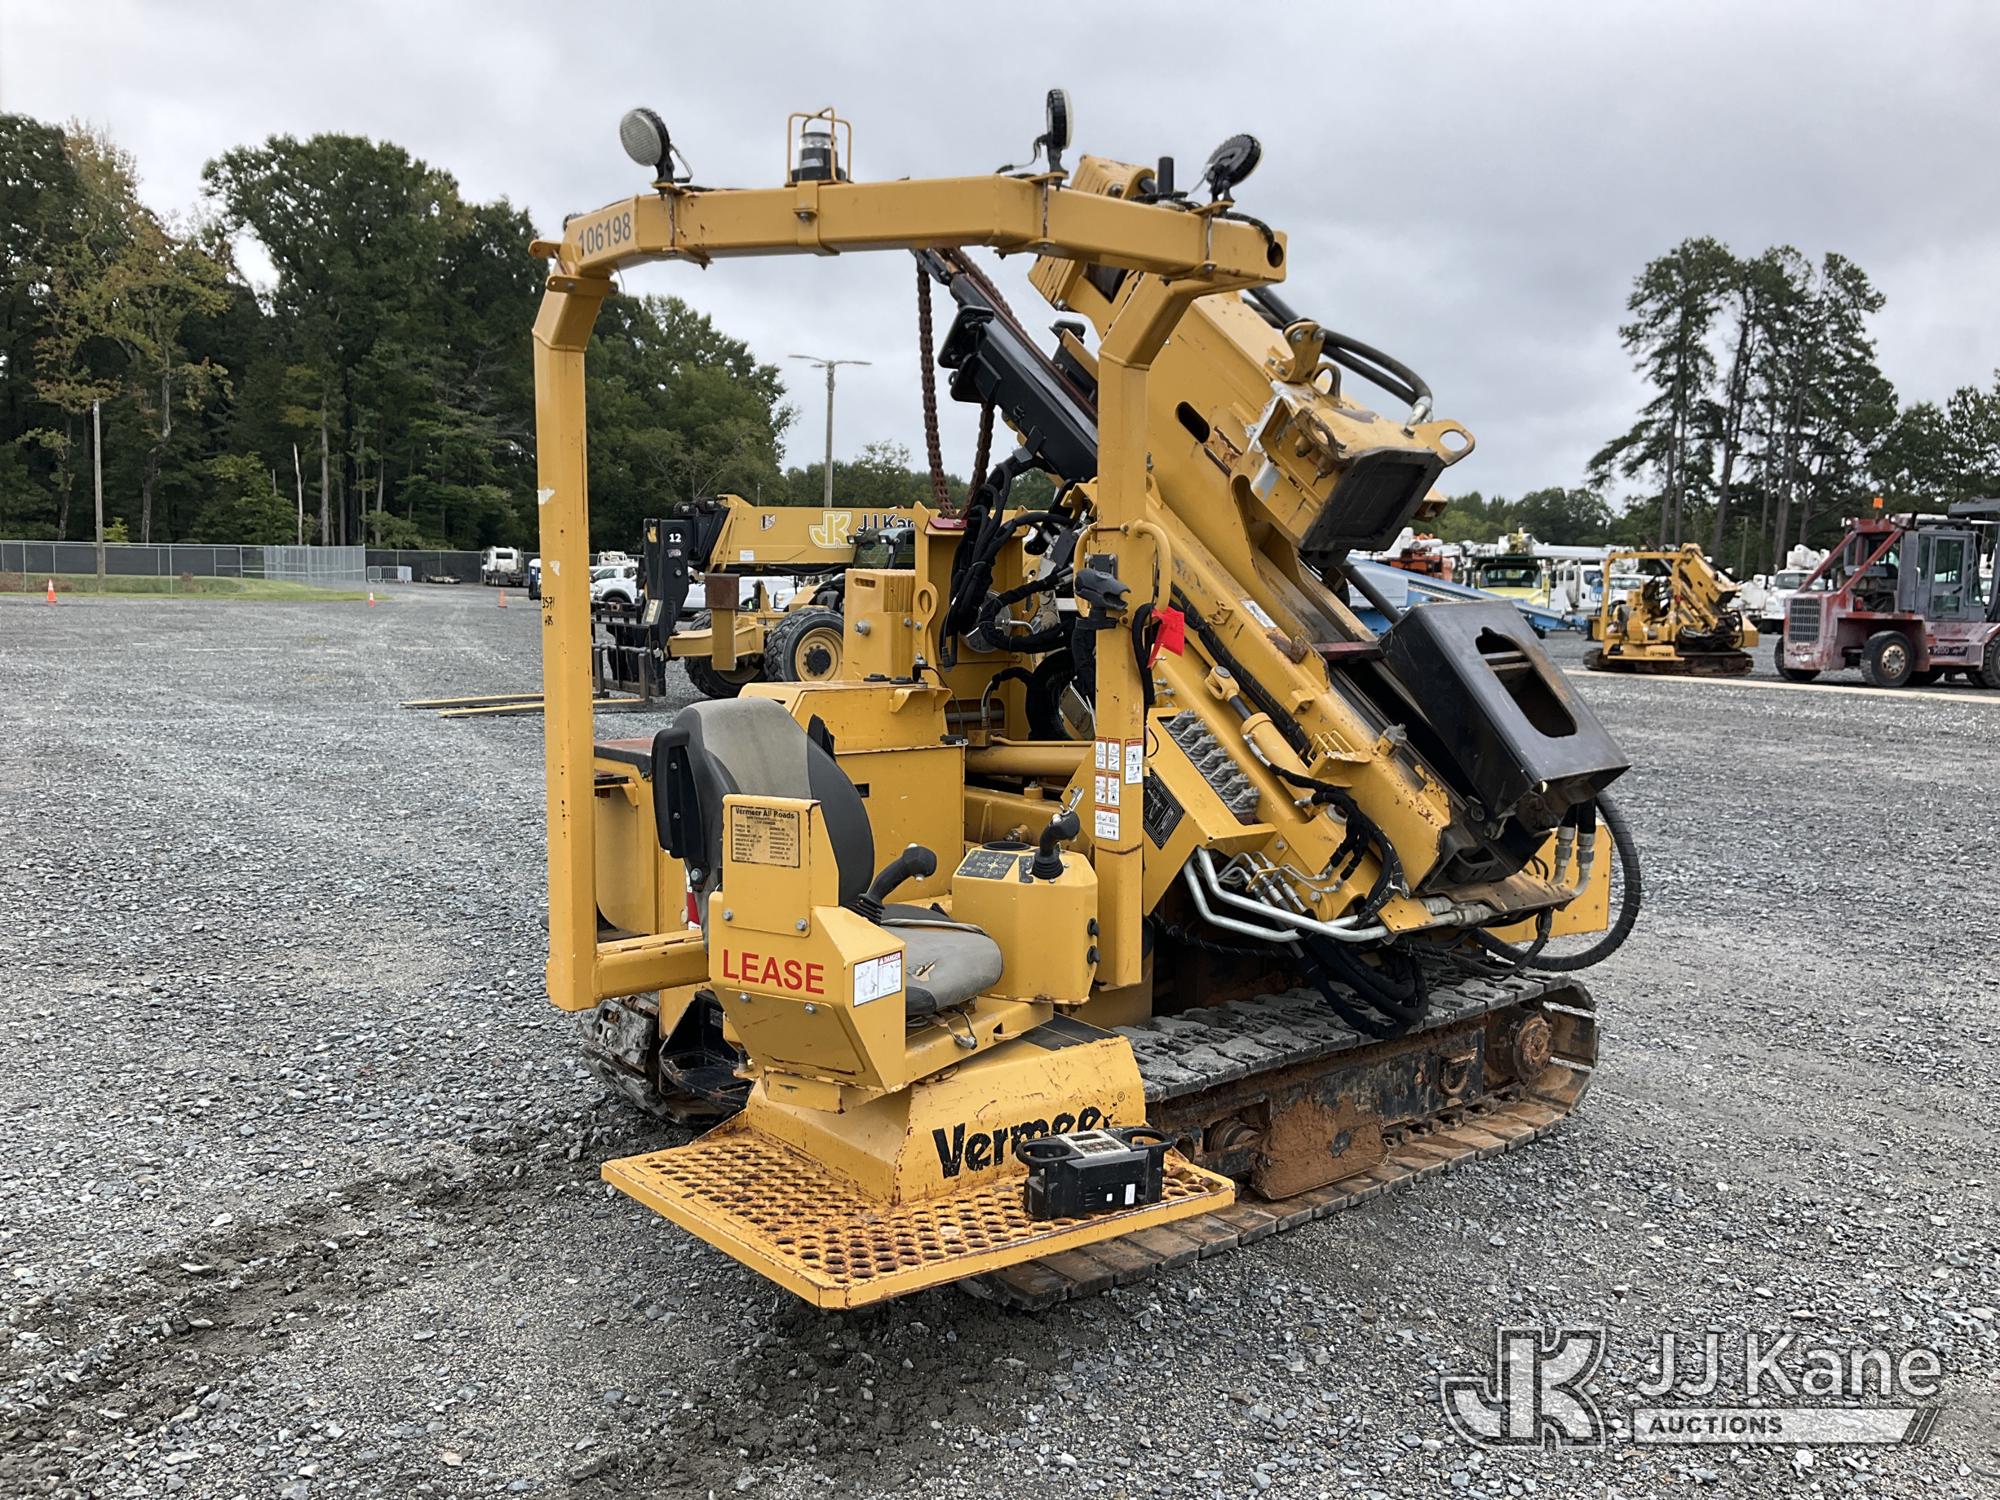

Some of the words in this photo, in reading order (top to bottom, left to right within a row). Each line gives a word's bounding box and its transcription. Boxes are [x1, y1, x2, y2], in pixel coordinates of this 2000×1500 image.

[578, 212, 631, 257] 106198
[669, 533, 682, 543] 12
[722, 949, 825, 995] LEASE
